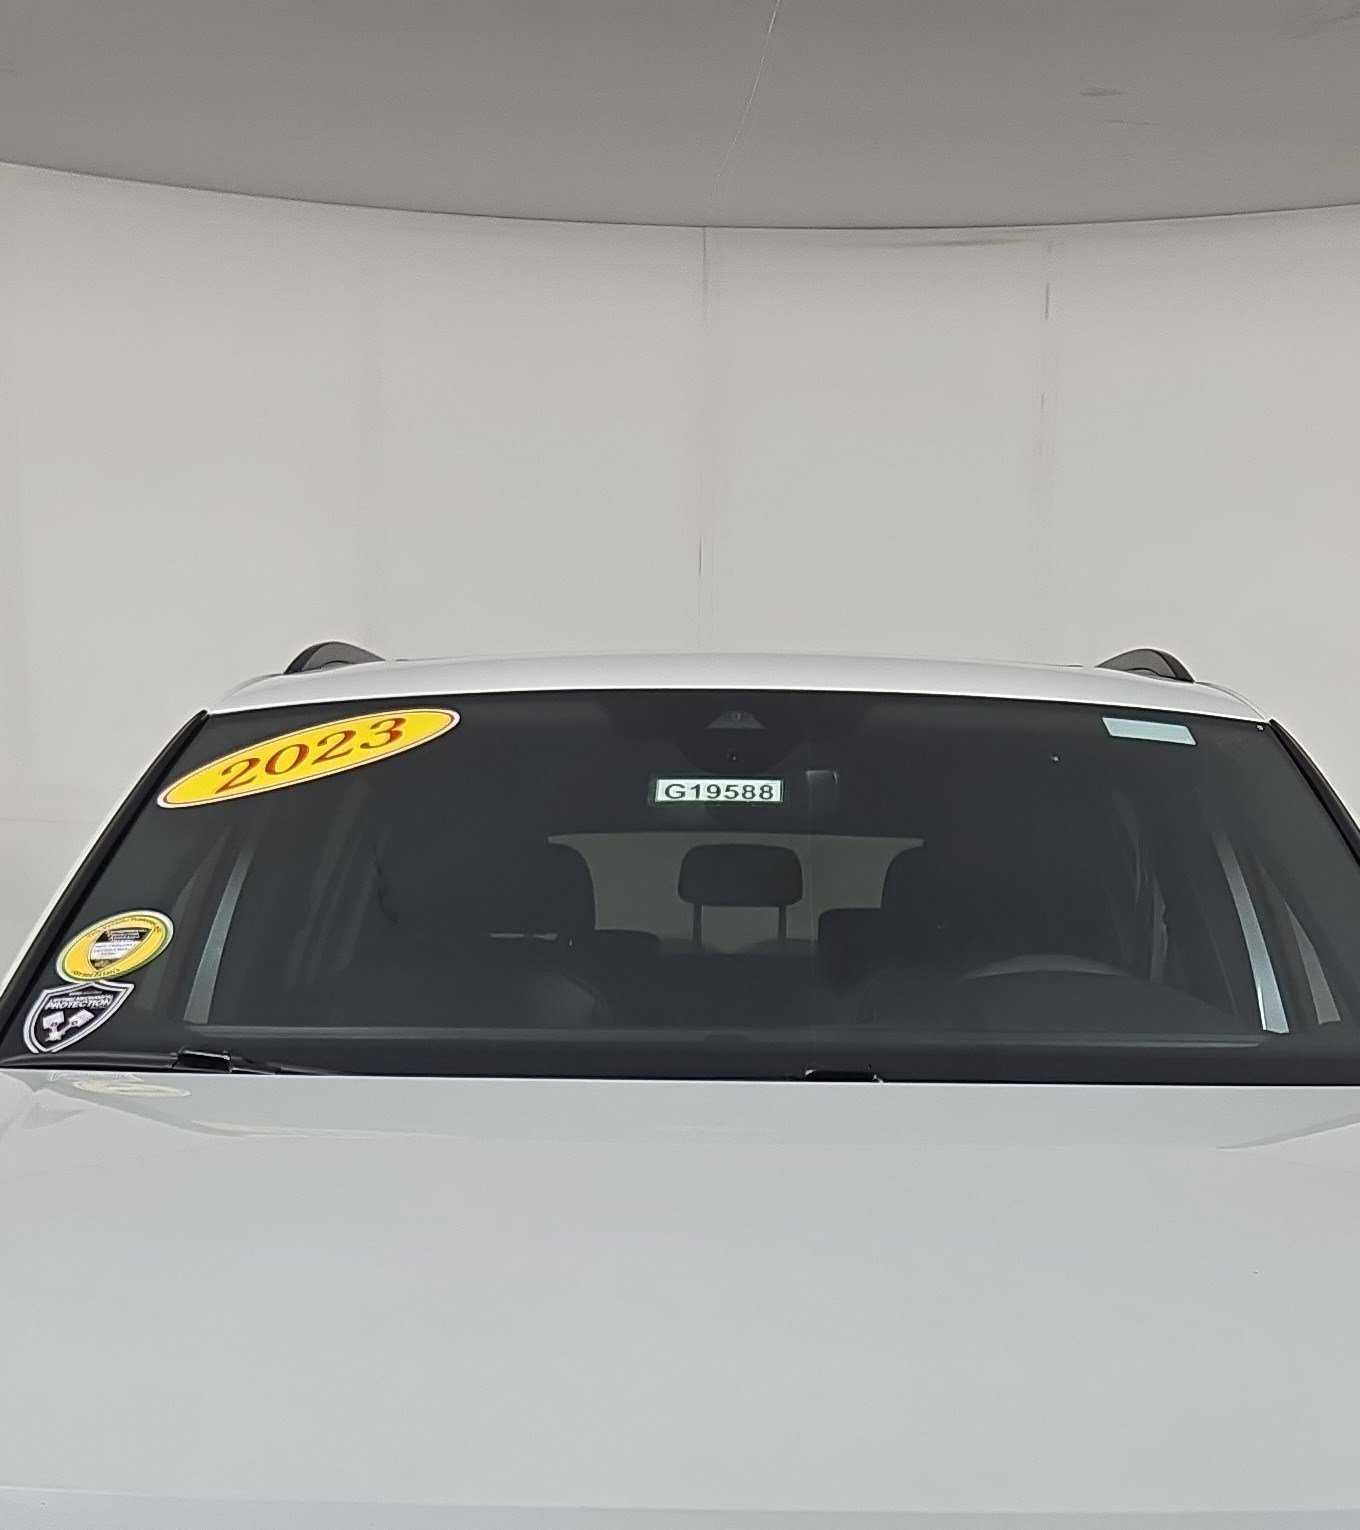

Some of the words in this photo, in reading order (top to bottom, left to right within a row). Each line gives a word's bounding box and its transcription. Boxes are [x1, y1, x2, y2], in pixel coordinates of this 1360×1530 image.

[214, 717, 407, 795] 2023
[664, 783, 774, 800] G19588
[44, 997, 112, 1011] PROTECTION
